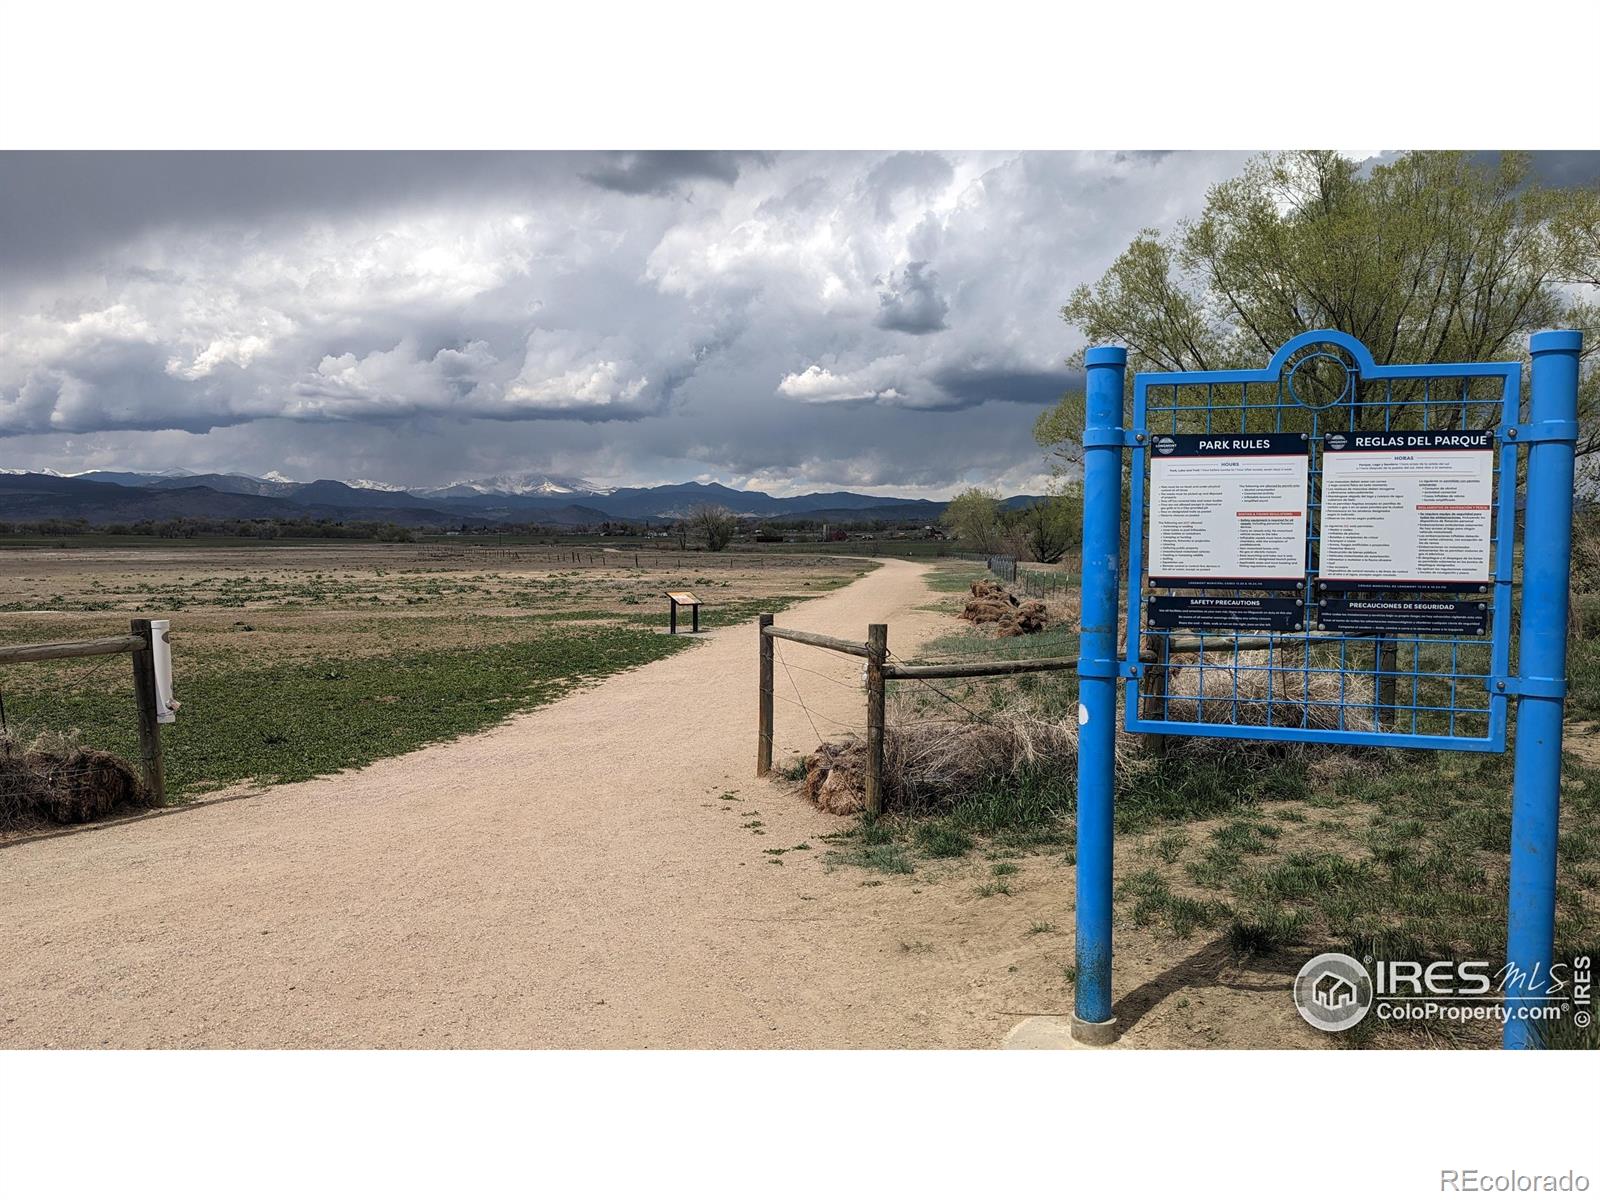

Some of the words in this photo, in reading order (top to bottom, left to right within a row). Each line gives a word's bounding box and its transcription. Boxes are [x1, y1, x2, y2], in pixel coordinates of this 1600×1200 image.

[1199, 440, 1230, 450] PARK
[1232, 439, 1271, 450] RULES
[1355, 436, 1404, 447] REGLAS
[1407, 435, 1432, 446] DEL
[1434, 435, 1488, 448] PARQUE
